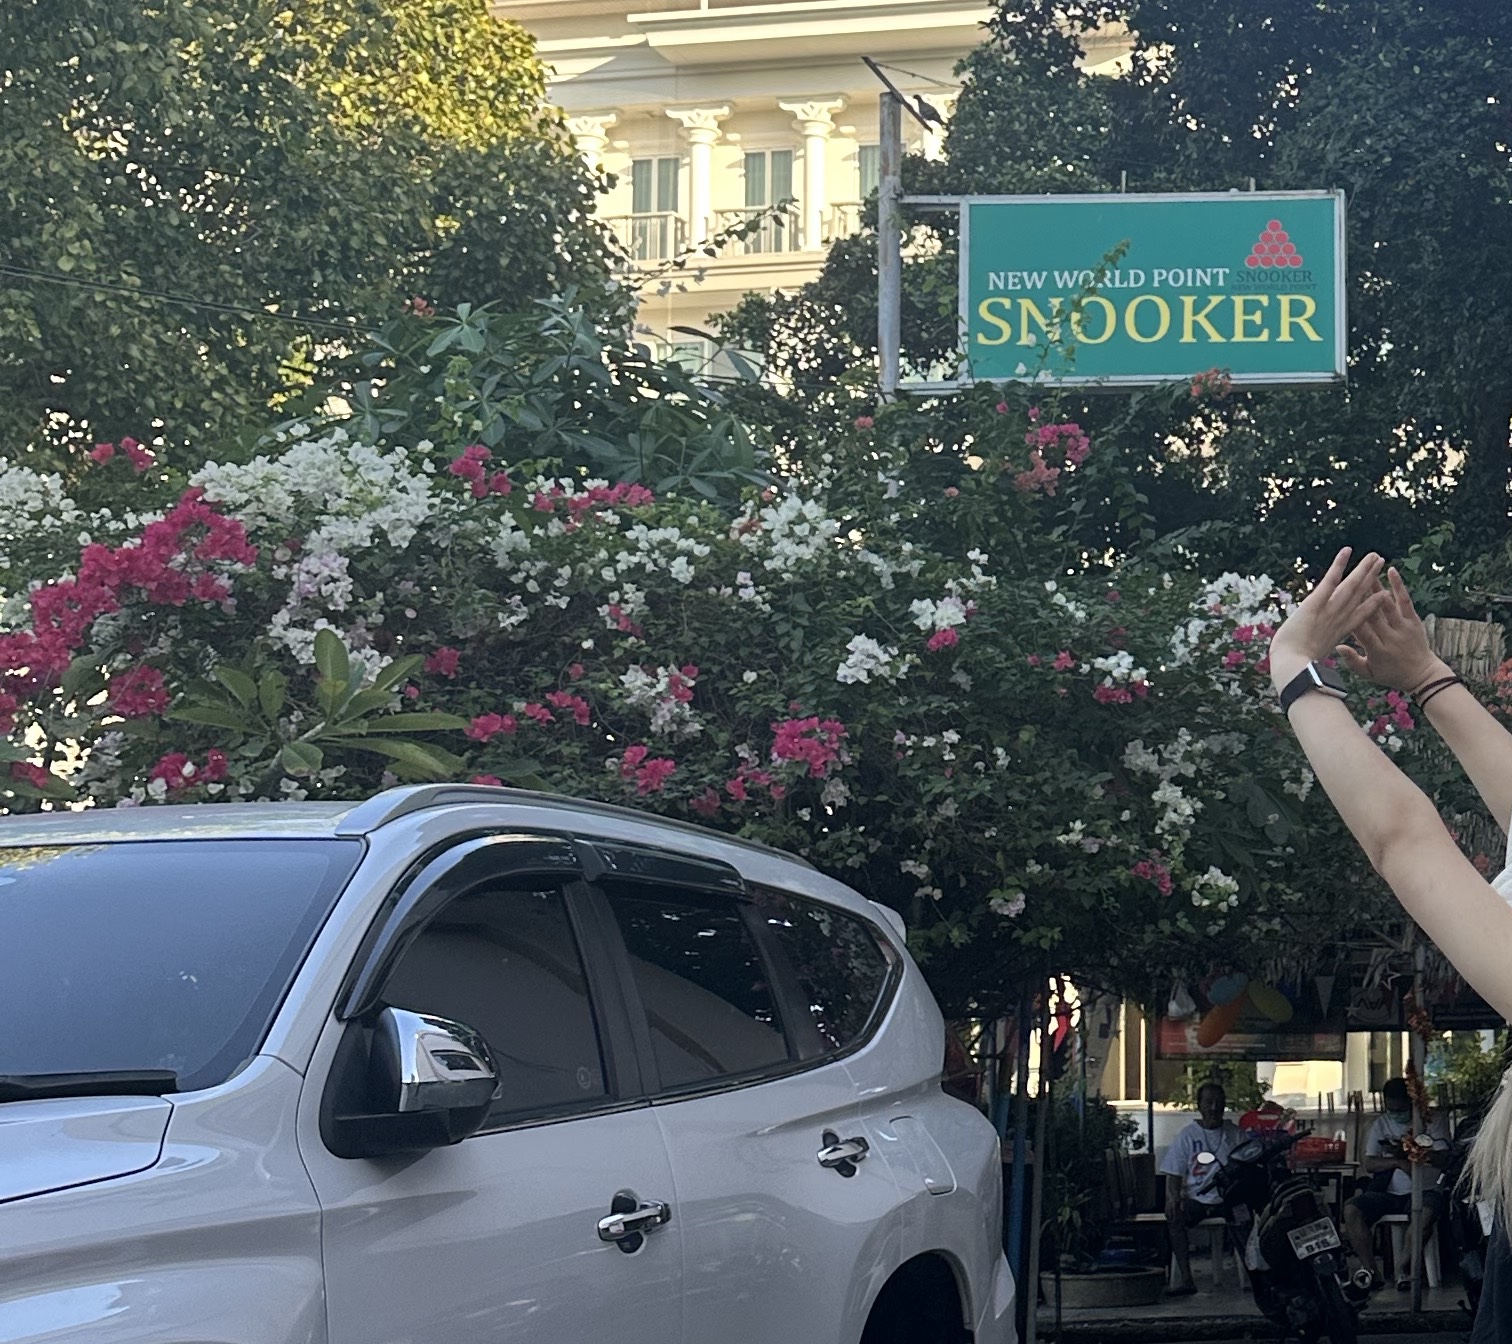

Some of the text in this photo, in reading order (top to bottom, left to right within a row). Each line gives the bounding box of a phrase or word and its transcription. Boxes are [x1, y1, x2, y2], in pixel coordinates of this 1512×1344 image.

[988, 267, 1230, 290] NEW WORLD POINT
[1236, 270, 1312, 283] SNOOKER
[977, 294, 1323, 345] SNOOKER
